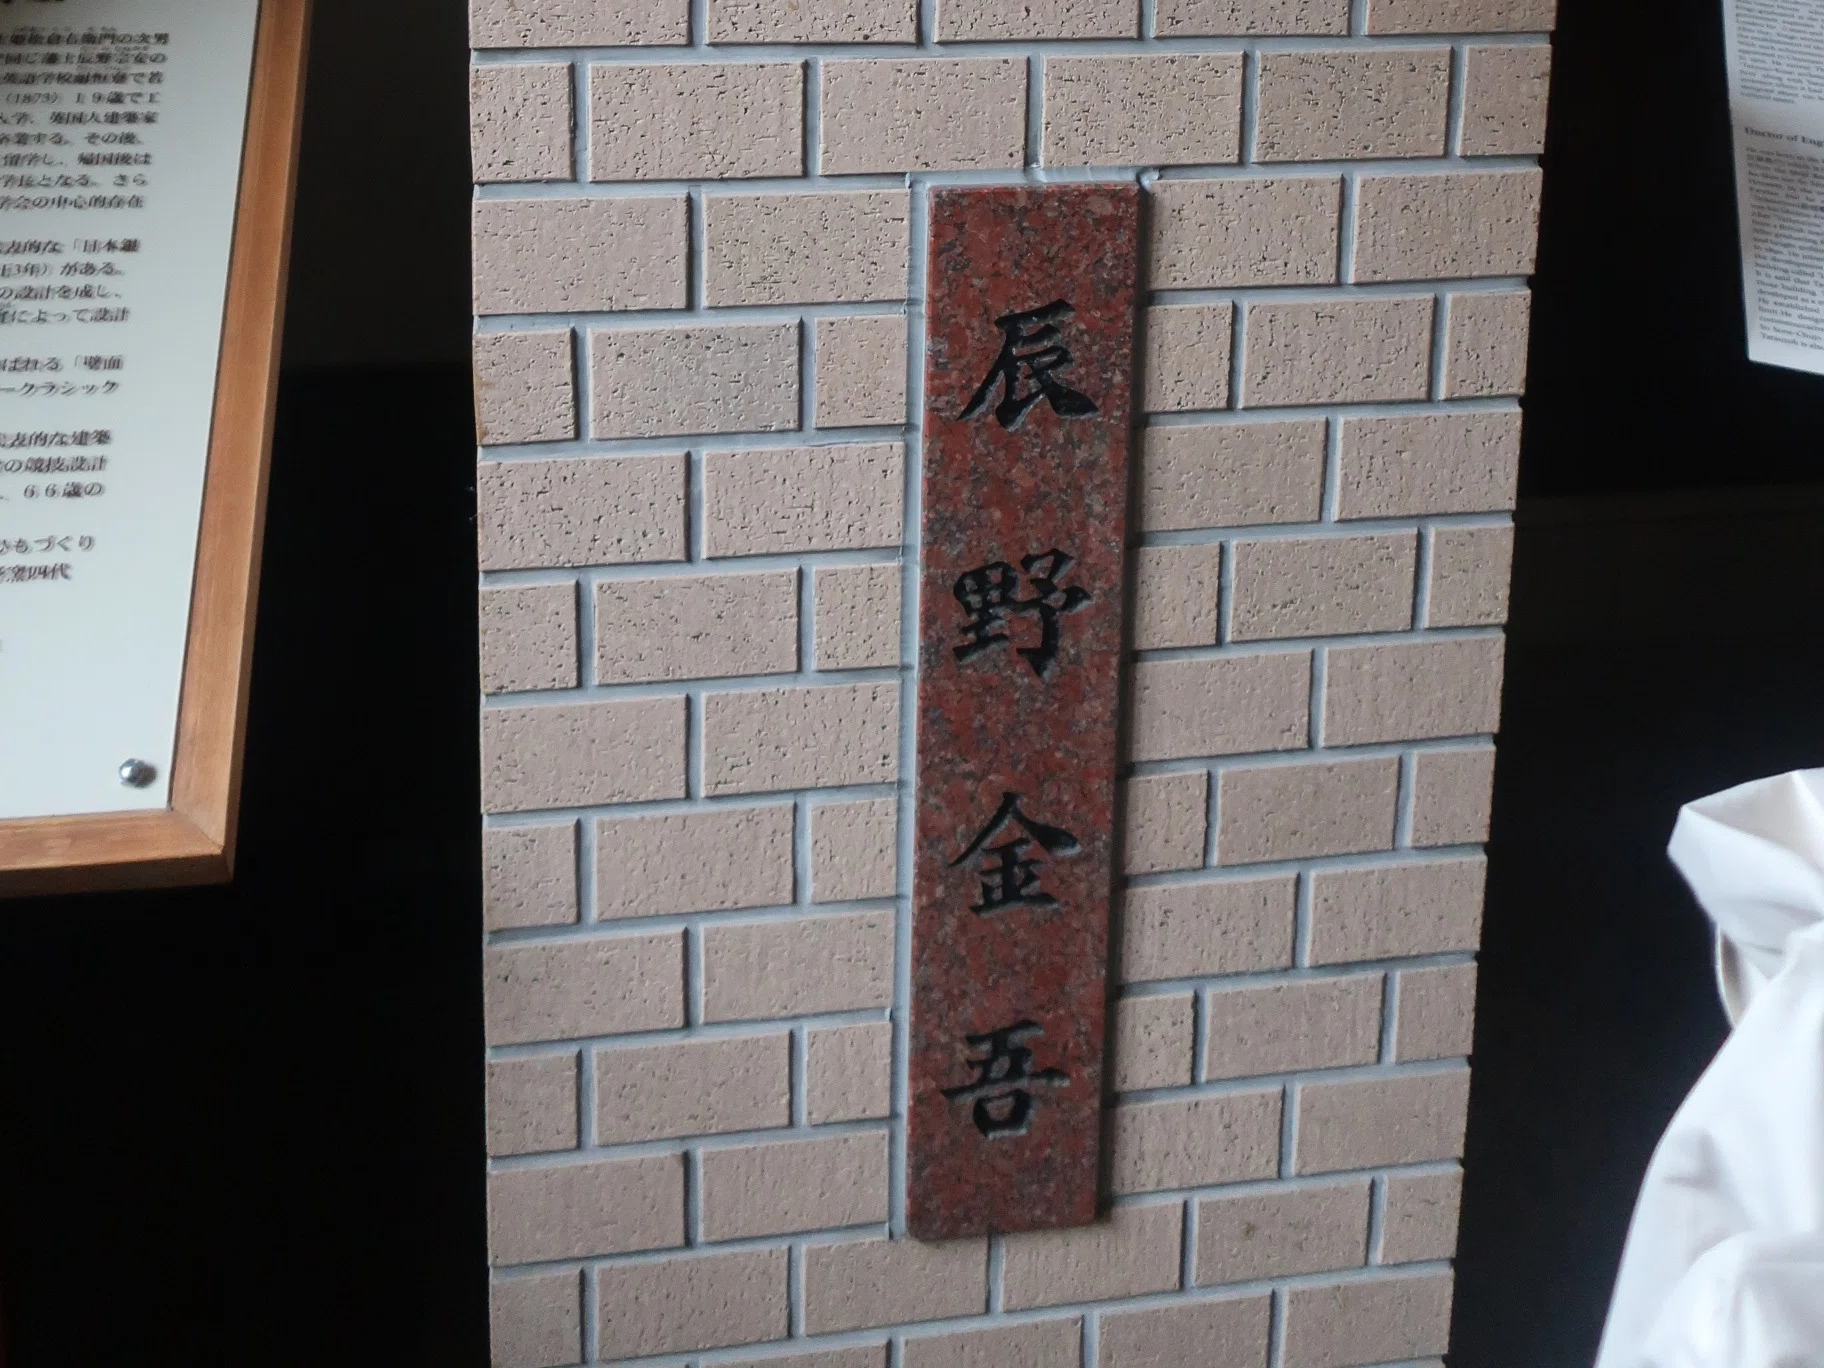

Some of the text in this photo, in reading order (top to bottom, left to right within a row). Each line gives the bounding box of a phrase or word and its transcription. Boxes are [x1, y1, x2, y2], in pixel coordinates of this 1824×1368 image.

[0, 238, 141, 255] 表的な「日本銀
[0, 430, 112, 447] 表的な建築
[941, 298, 1100, 1138] 辰野金吾
